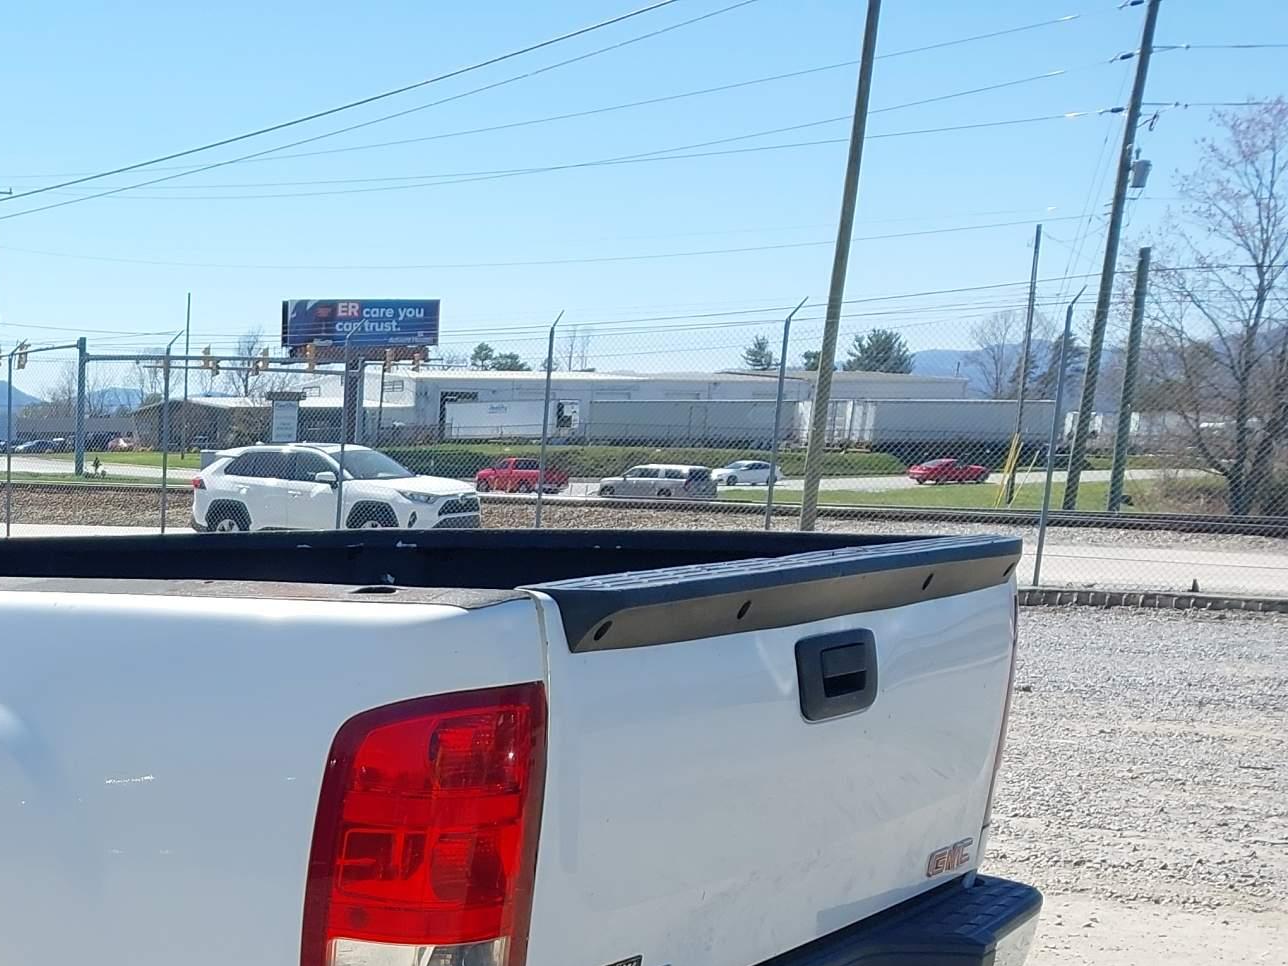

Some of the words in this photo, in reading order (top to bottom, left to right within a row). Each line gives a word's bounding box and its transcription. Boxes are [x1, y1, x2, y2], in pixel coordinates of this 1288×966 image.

[337, 302, 360, 317] ER
[363, 307, 394, 318] care
[399, 307, 425, 321] you
[335, 321, 361, 332] can
[364, 320, 401, 332] trust.
[926, 837, 973, 878] GMC
